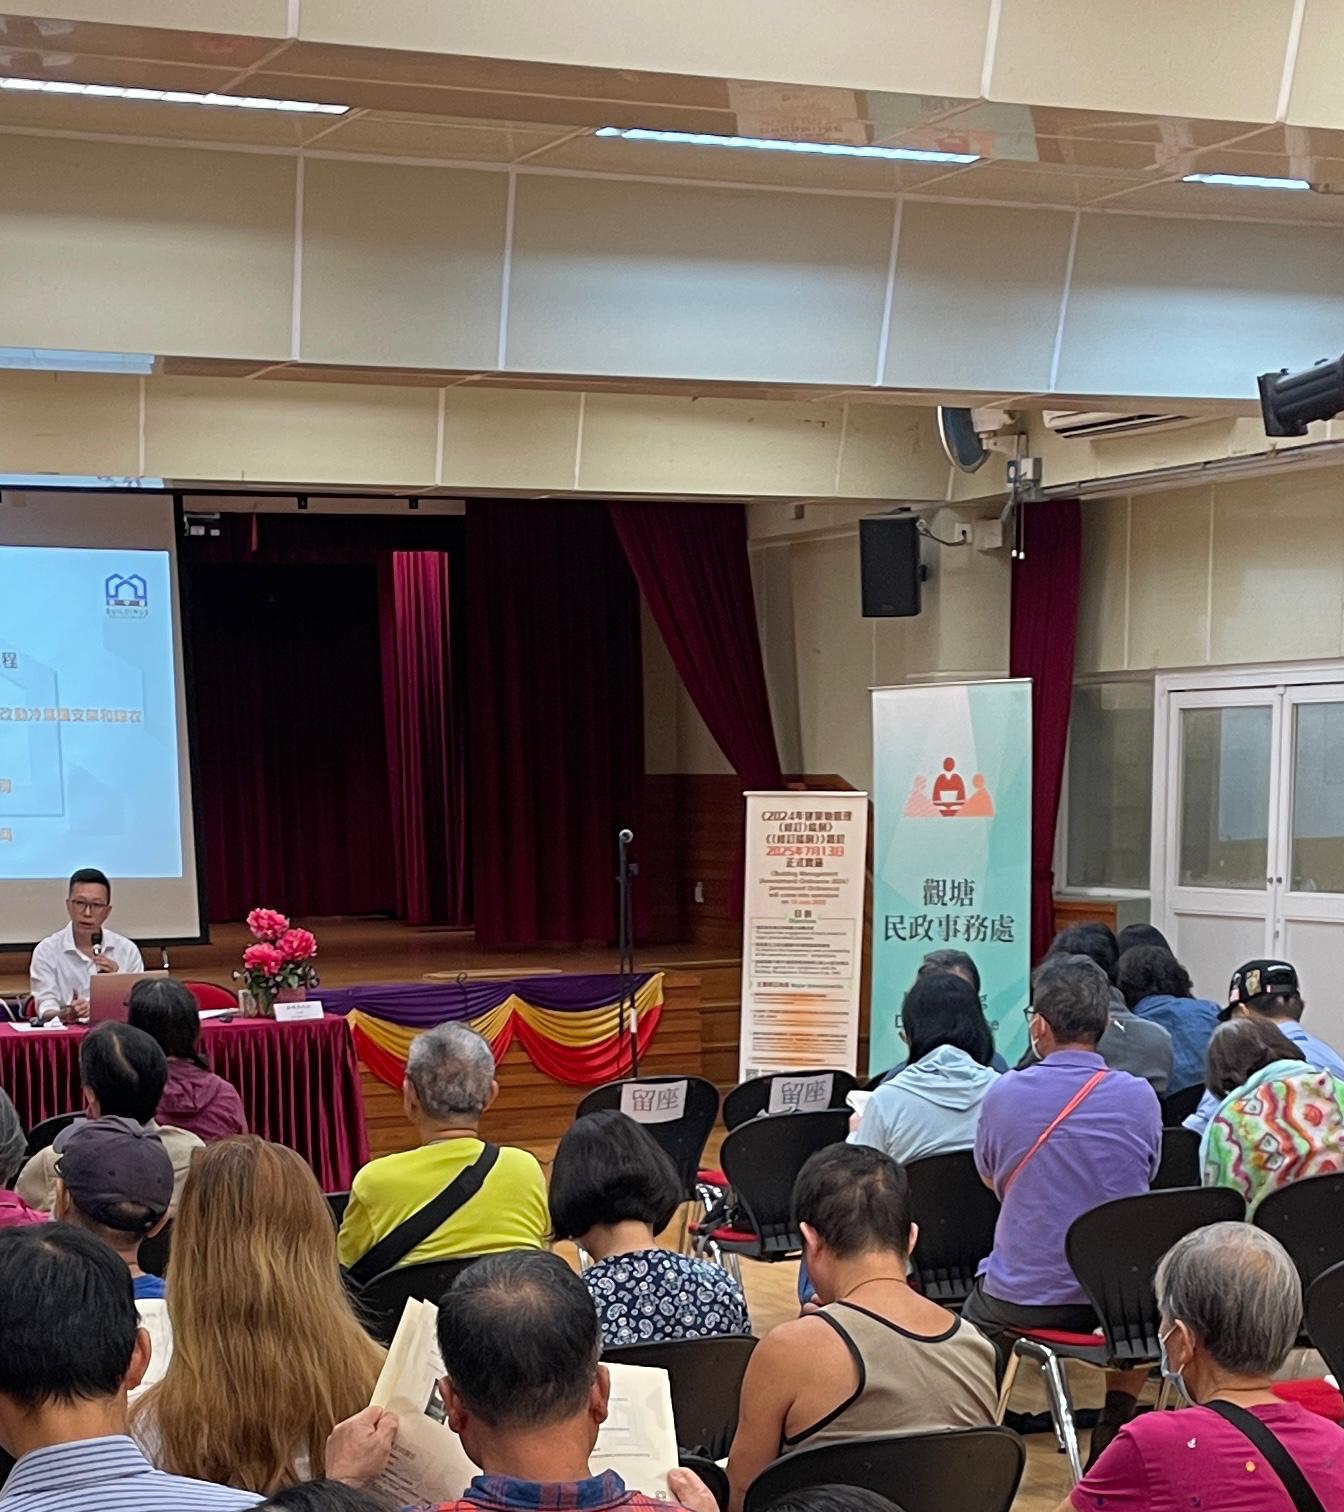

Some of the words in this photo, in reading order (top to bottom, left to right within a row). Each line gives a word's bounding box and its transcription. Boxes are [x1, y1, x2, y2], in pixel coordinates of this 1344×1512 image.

[923, 878, 975, 907] 觀塘
[884, 914, 1015, 942] 民政事務處
[632, 1087, 680, 1112] 留座
[781, 1080, 827, 1106] 留座
